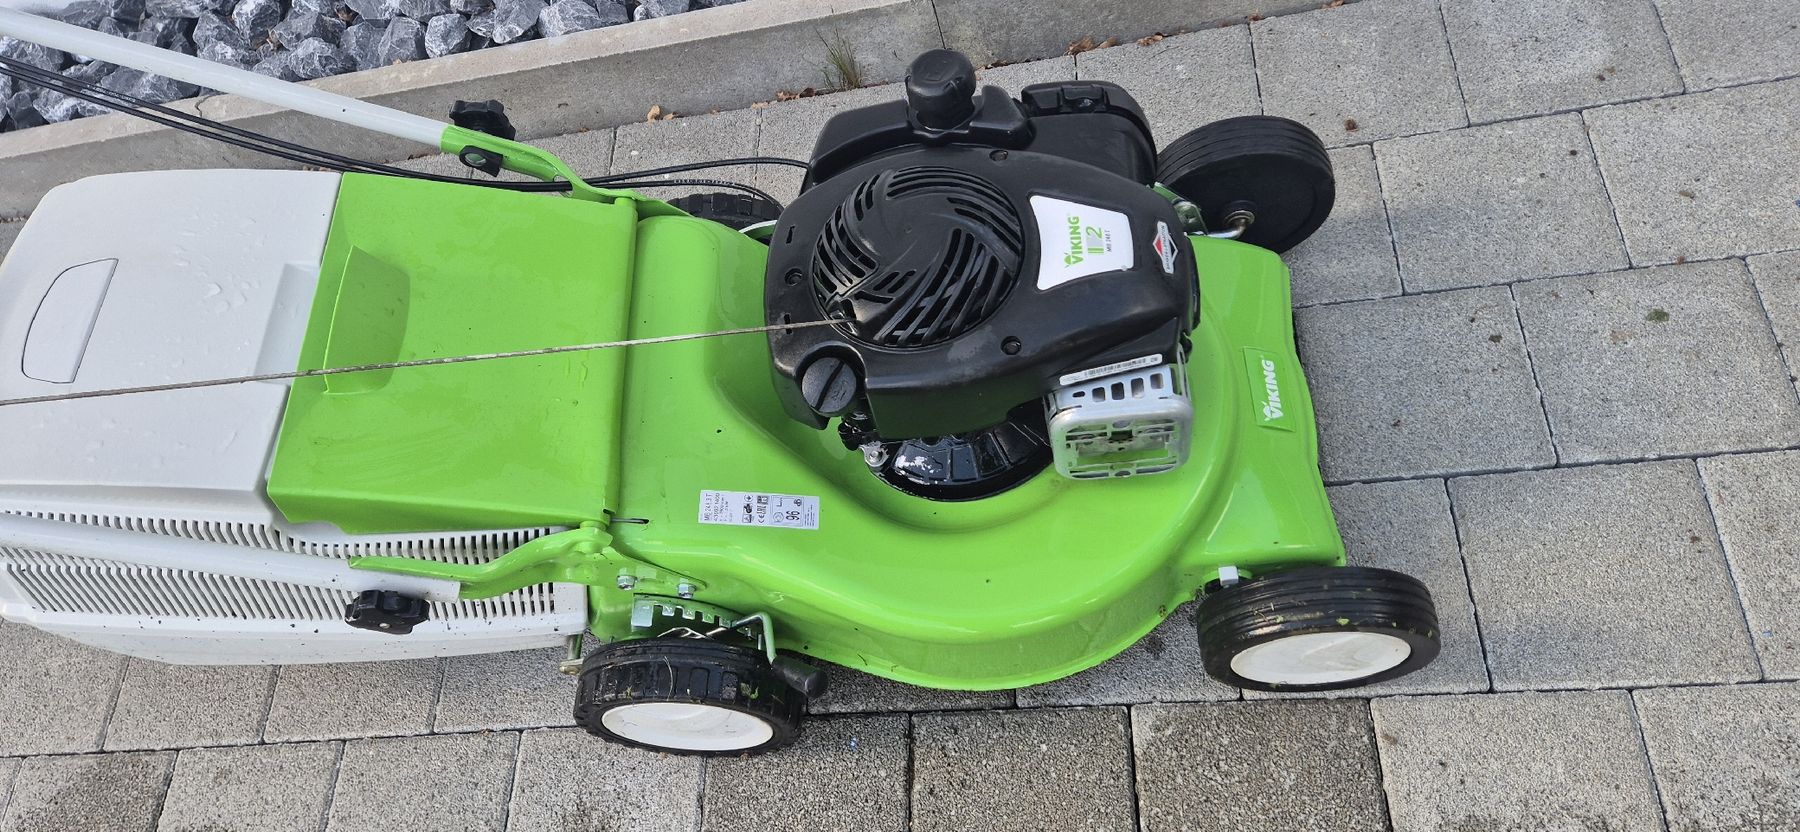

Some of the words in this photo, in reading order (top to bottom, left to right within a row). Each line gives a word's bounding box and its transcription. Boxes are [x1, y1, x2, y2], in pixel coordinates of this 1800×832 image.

[1066, 216, 1083, 265] VIKING
[1086, 226, 1103, 239] 2
[1262, 359, 1284, 420] VIKING
[785, 510, 800, 521] 96
